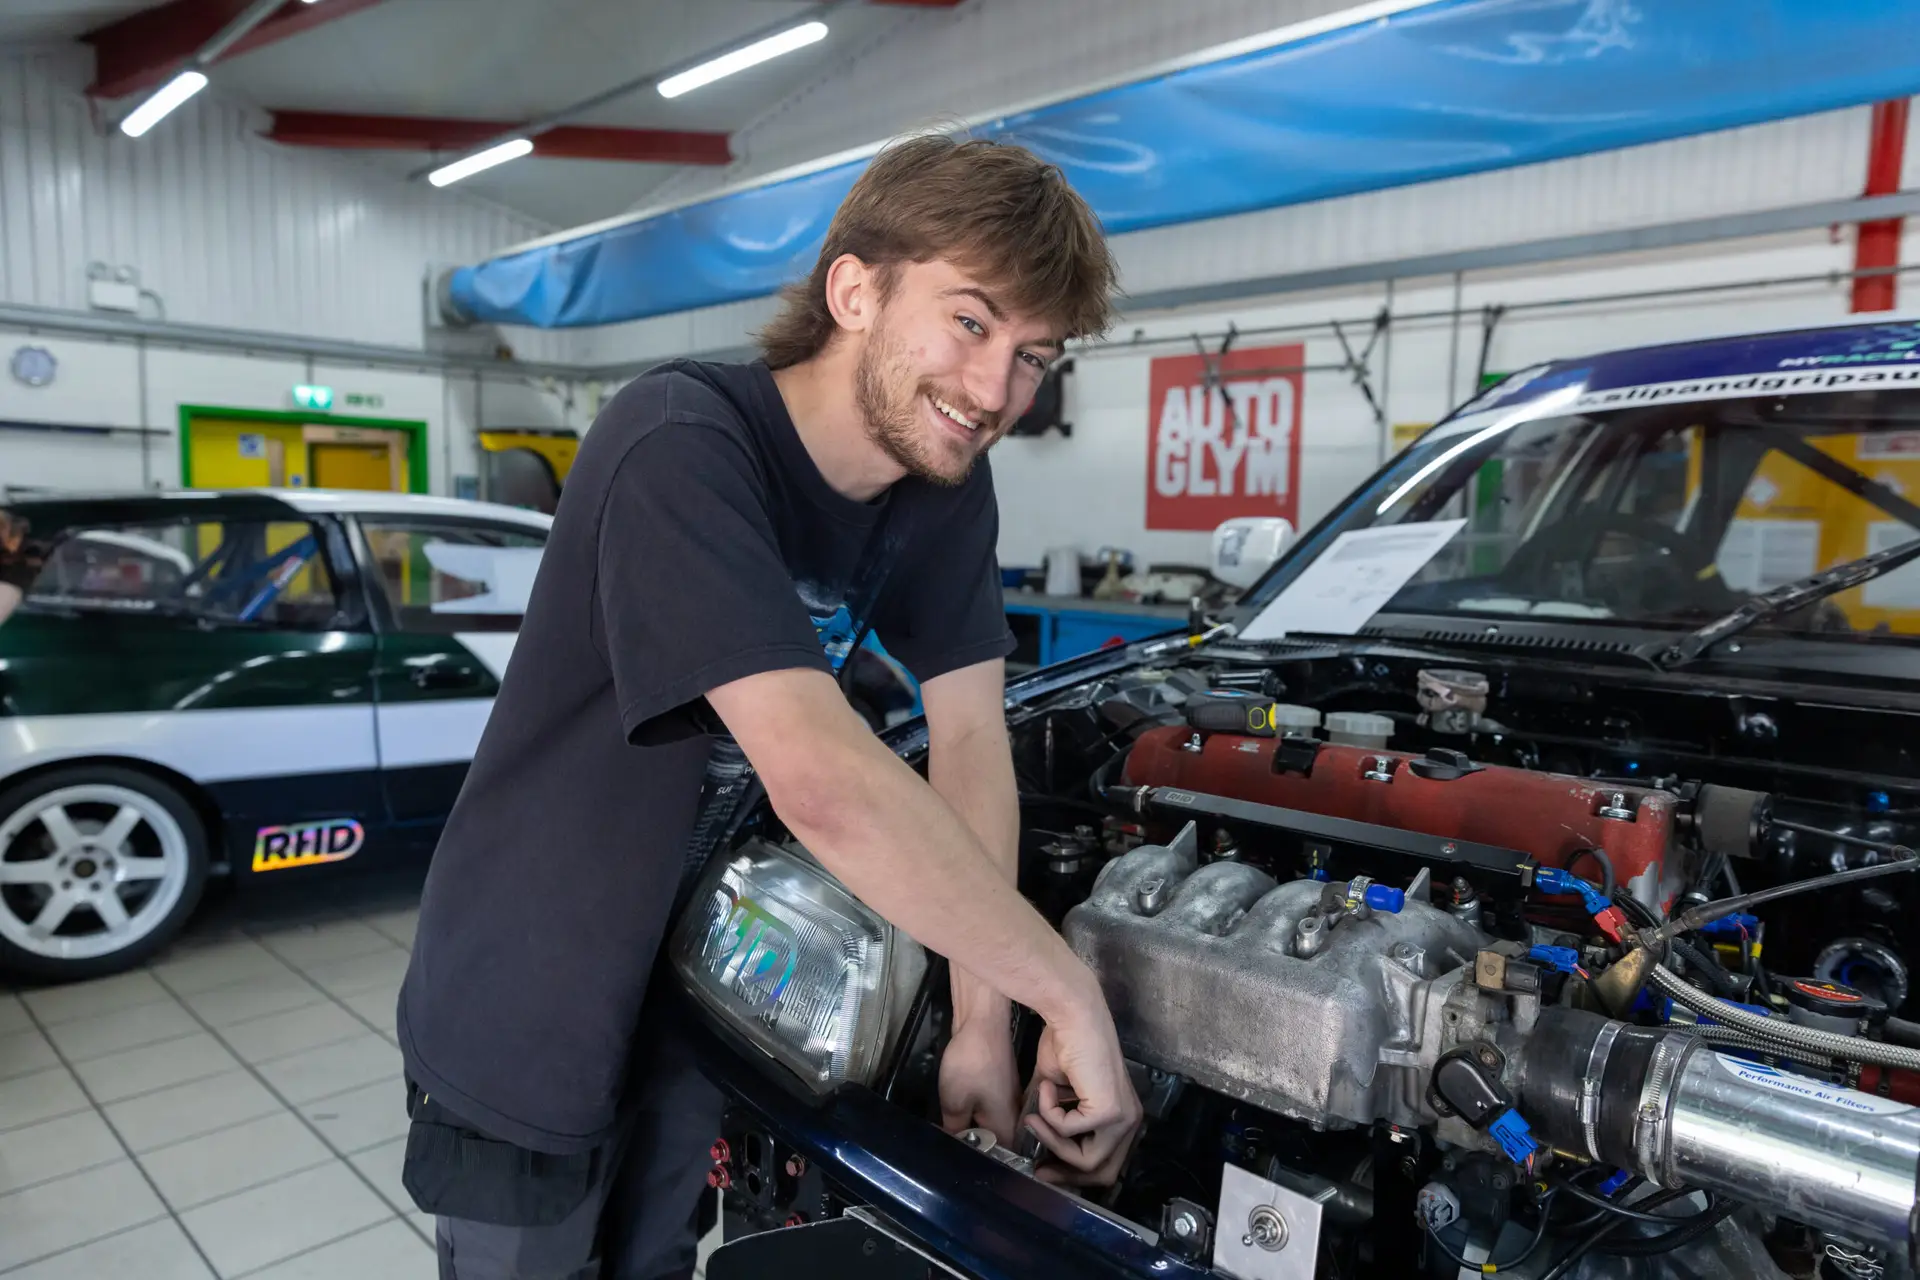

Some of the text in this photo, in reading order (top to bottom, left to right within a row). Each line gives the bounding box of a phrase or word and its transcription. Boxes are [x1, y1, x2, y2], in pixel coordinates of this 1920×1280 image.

[1157, 377, 1294, 443] AUTO
[1155, 436, 1291, 497] GLYM
[256, 821, 361, 867] RHD
[1738, 1069, 1812, 1094] Performance
[1815, 1091, 1832, 1101] Air
[1836, 1096, 1875, 1112] Filters
